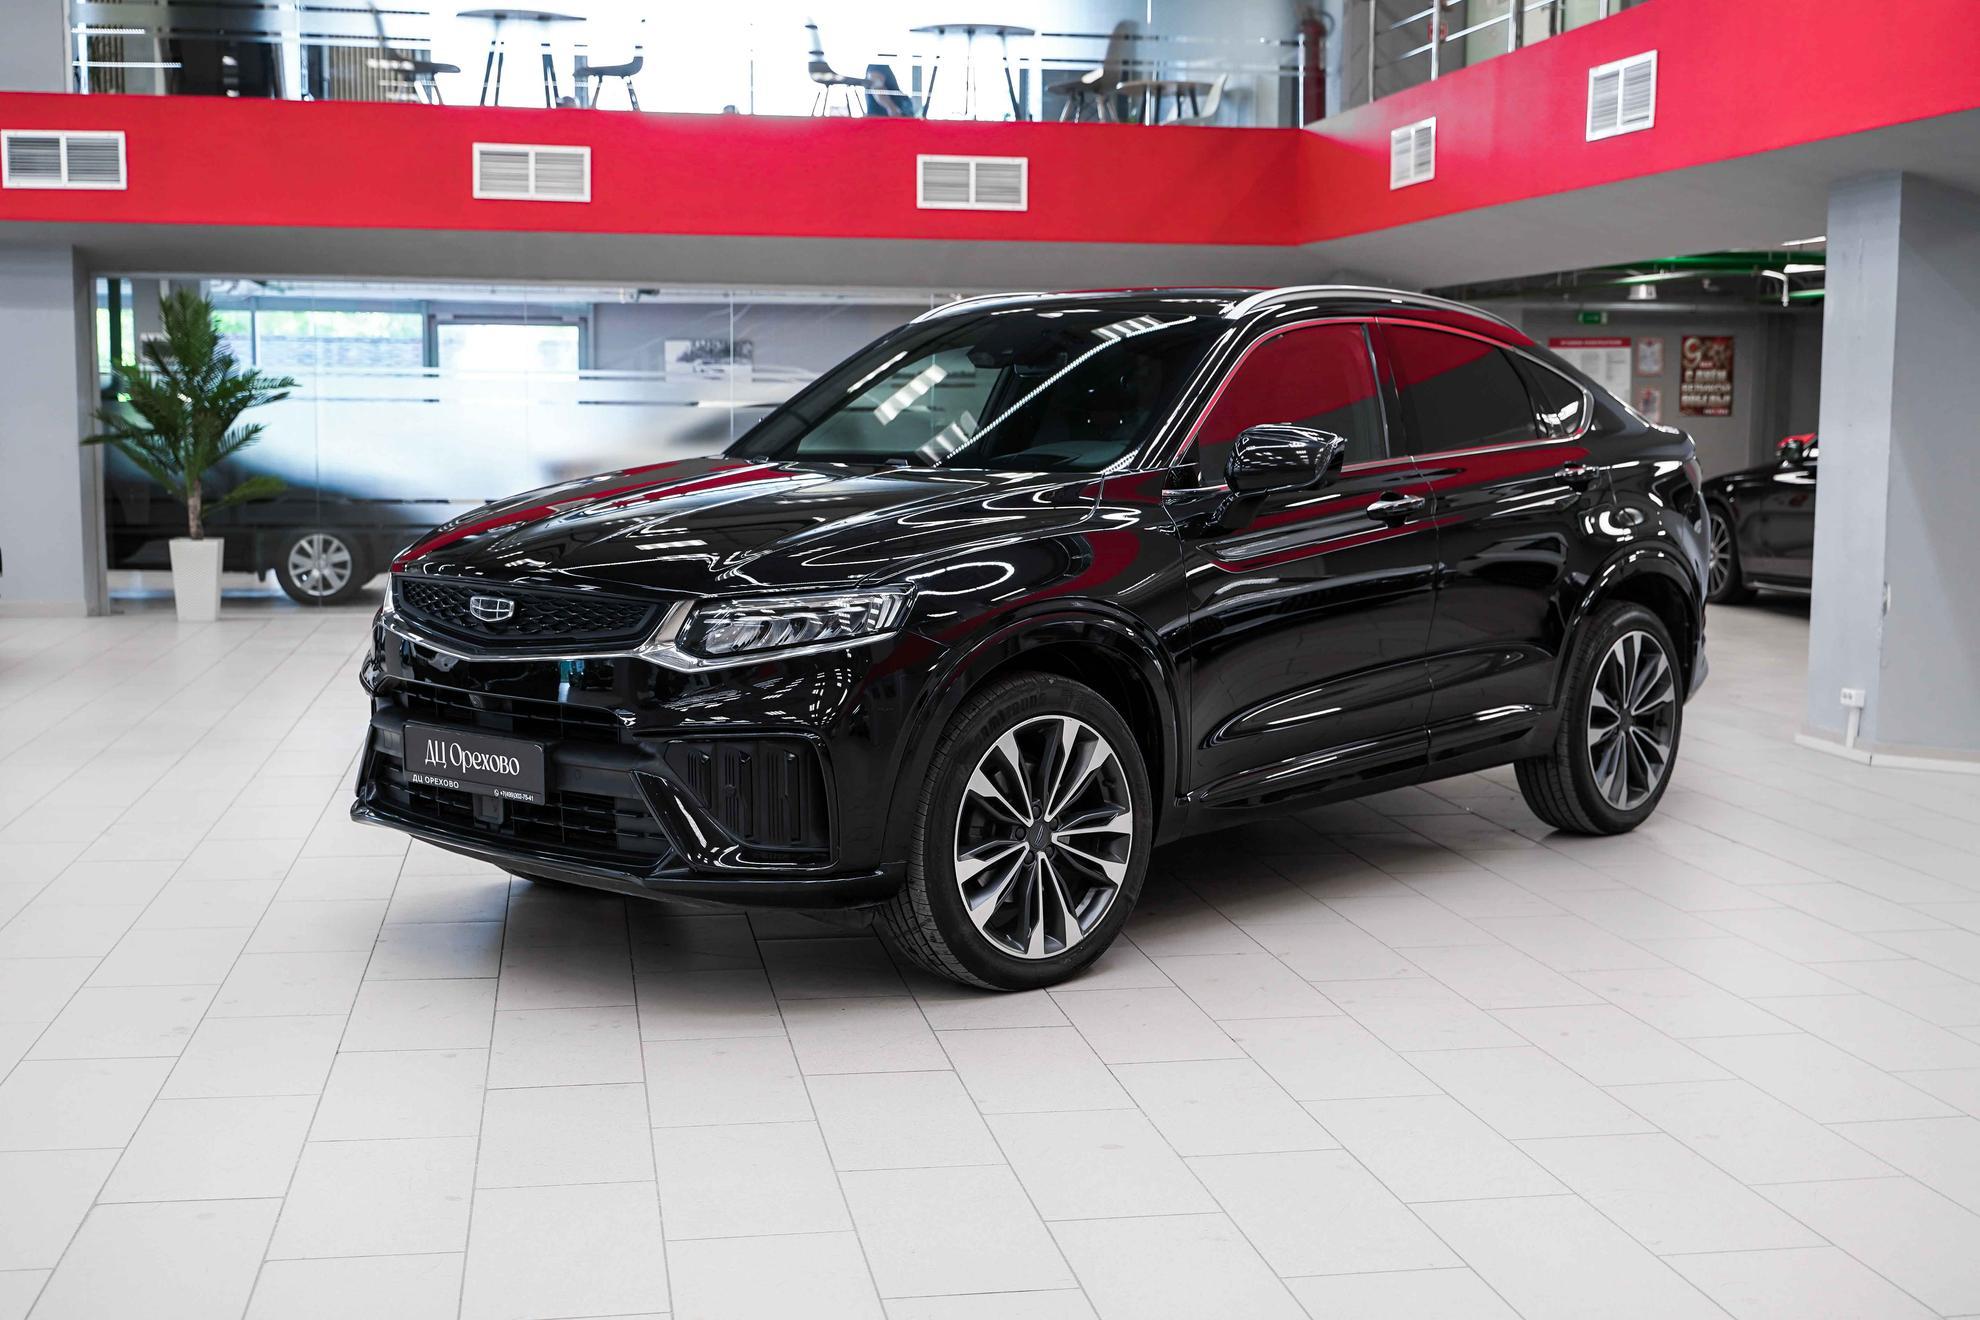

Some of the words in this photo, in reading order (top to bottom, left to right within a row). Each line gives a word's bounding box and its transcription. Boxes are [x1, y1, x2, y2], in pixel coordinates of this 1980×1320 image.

[425, 739, 447, 769] ДЦ
[450, 743, 520, 775] Орехово
[413, 774, 423, 784] ДЦ
[425, 776, 459, 788] ОРЕХОВО
